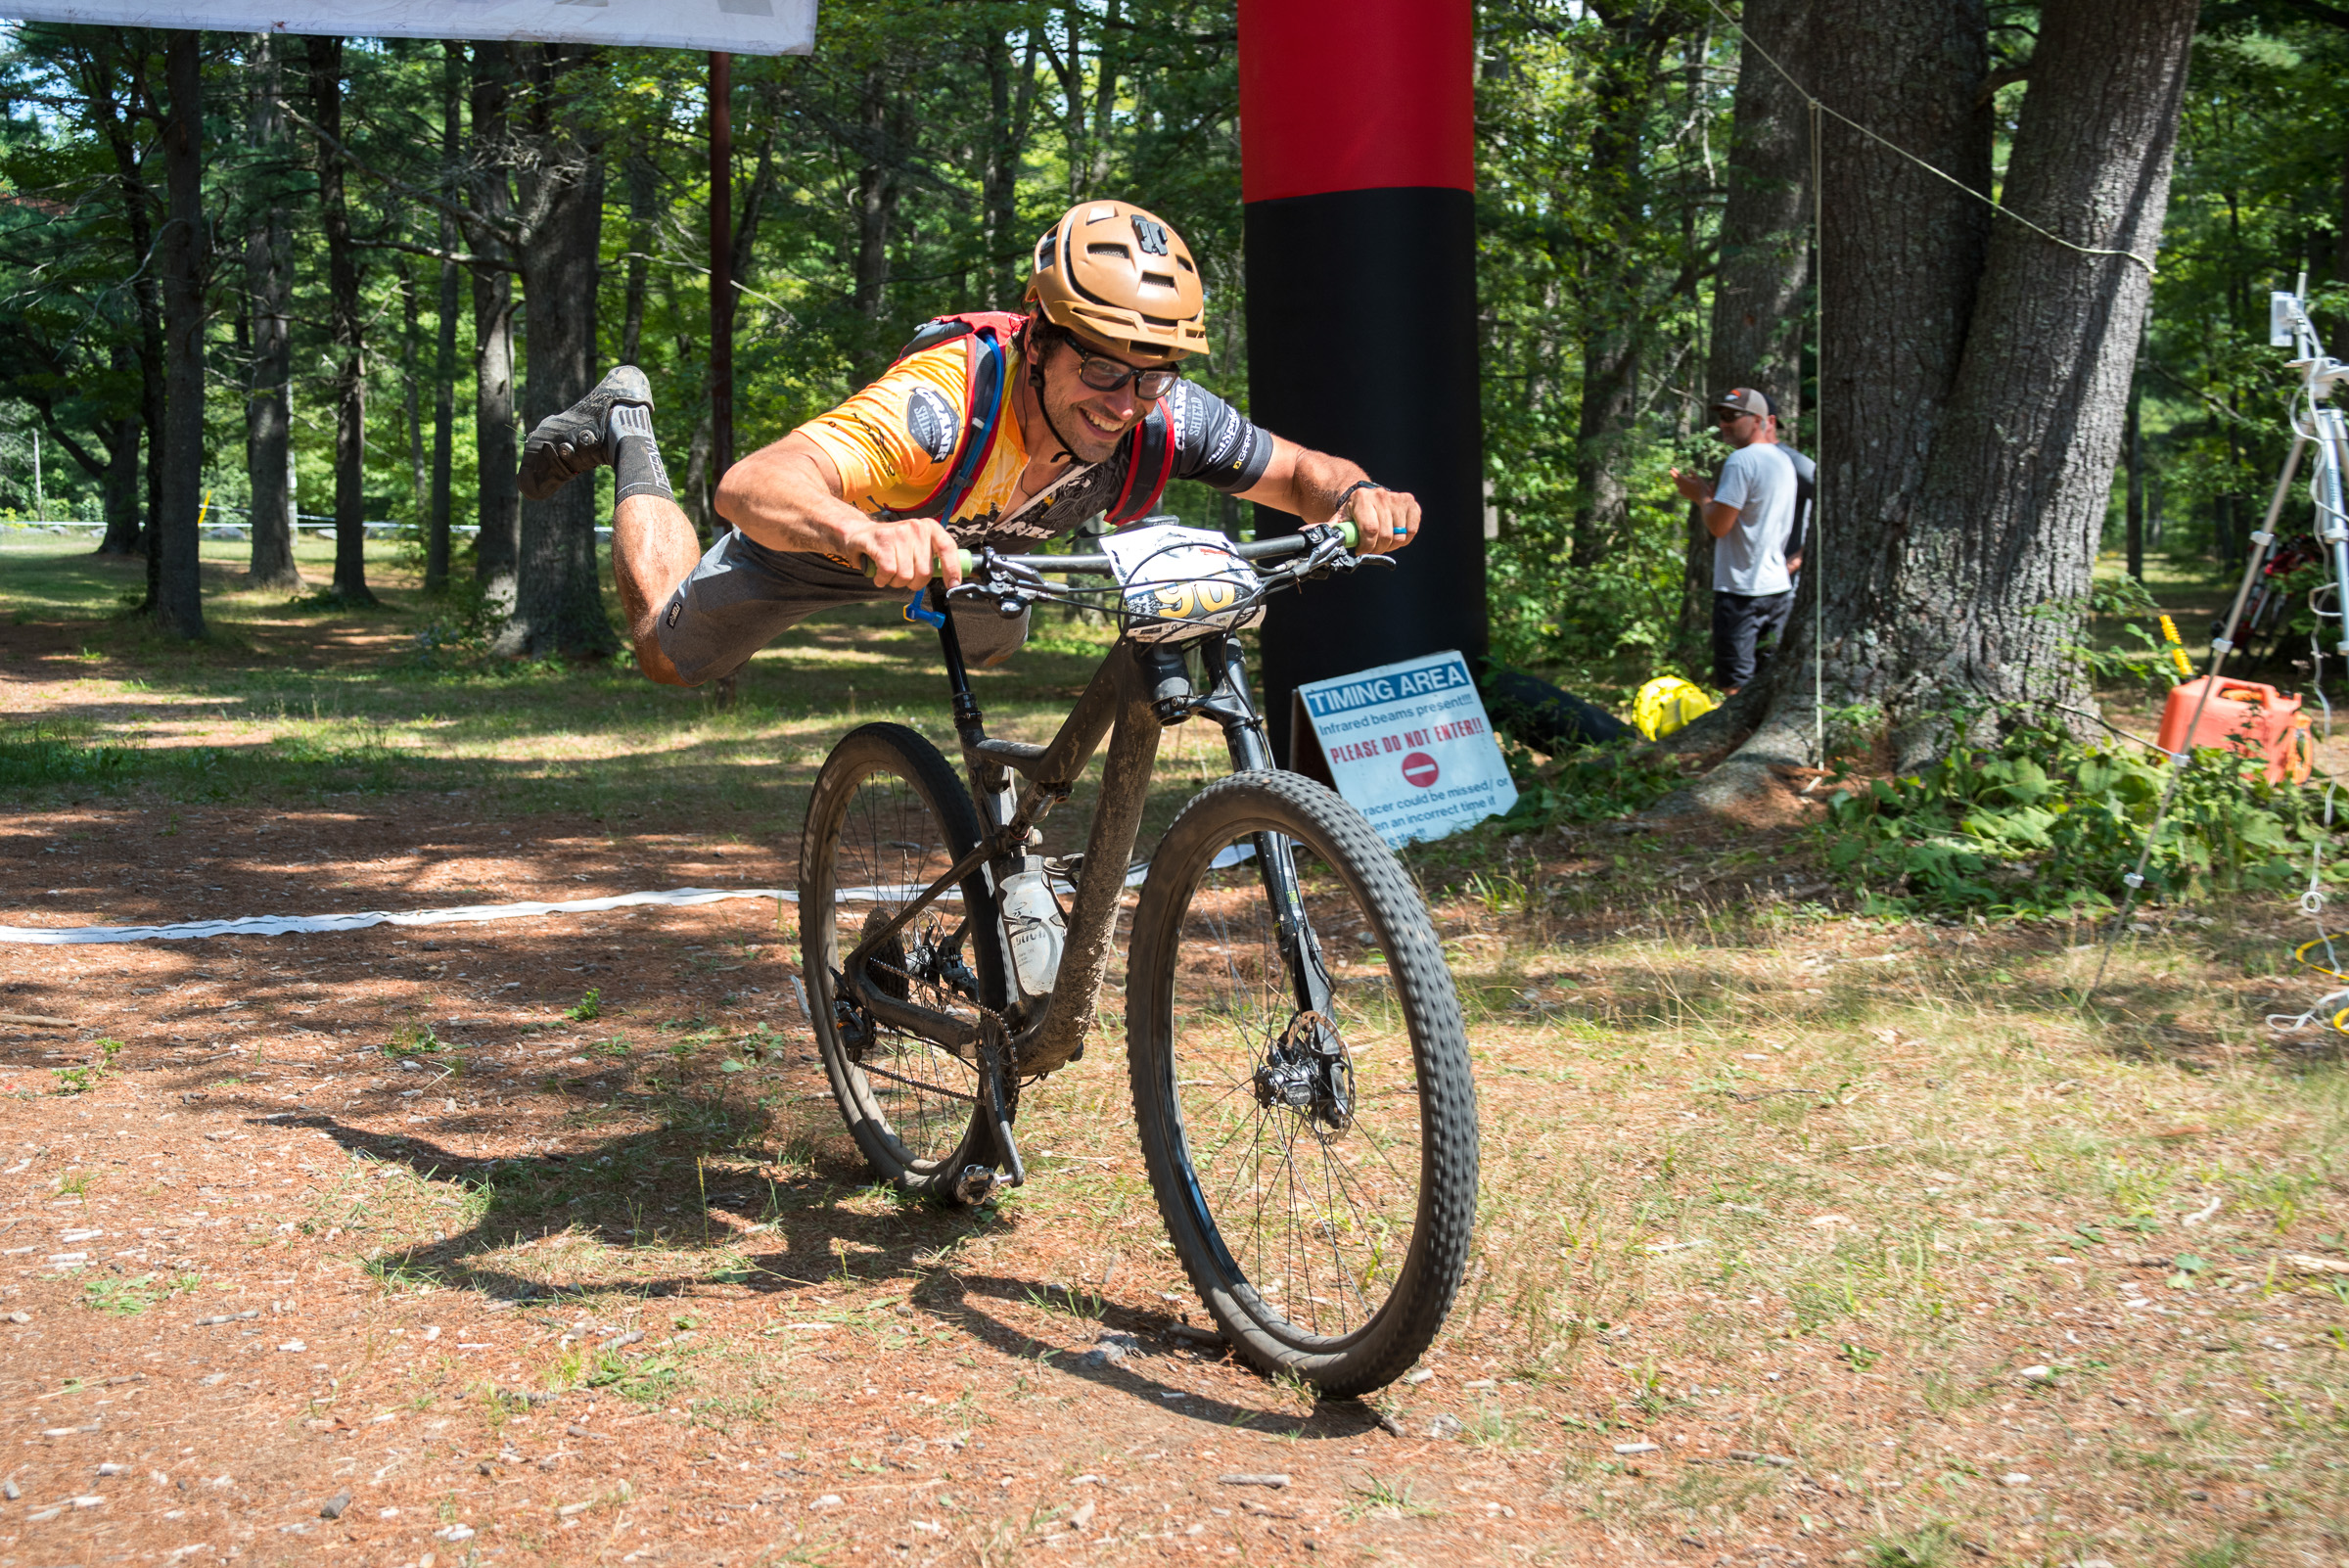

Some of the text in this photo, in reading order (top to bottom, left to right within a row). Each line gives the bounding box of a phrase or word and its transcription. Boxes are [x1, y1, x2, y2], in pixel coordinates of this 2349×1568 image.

[1188, 396, 1205, 437] SHIELD
[1154, 579, 1235, 619] 90
[1309, 665, 1466, 714] TIMING AREA
[1318, 715, 1370, 736] Infrared
[1371, 708, 1415, 725] beams
[1329, 716, 1485, 764] PLEASE DO NOT ENTER!!
[1363, 802, 1394, 816] racer
[1397, 793, 1429, 809] could
[1429, 790, 1446, 802] be
[1497, 777, 1508, 787] or
[1391, 817, 1405, 828] an
[1405, 803, 1460, 824] incorrect
[1460, 800, 1487, 811] time
[1488, 795, 1497, 806] if
